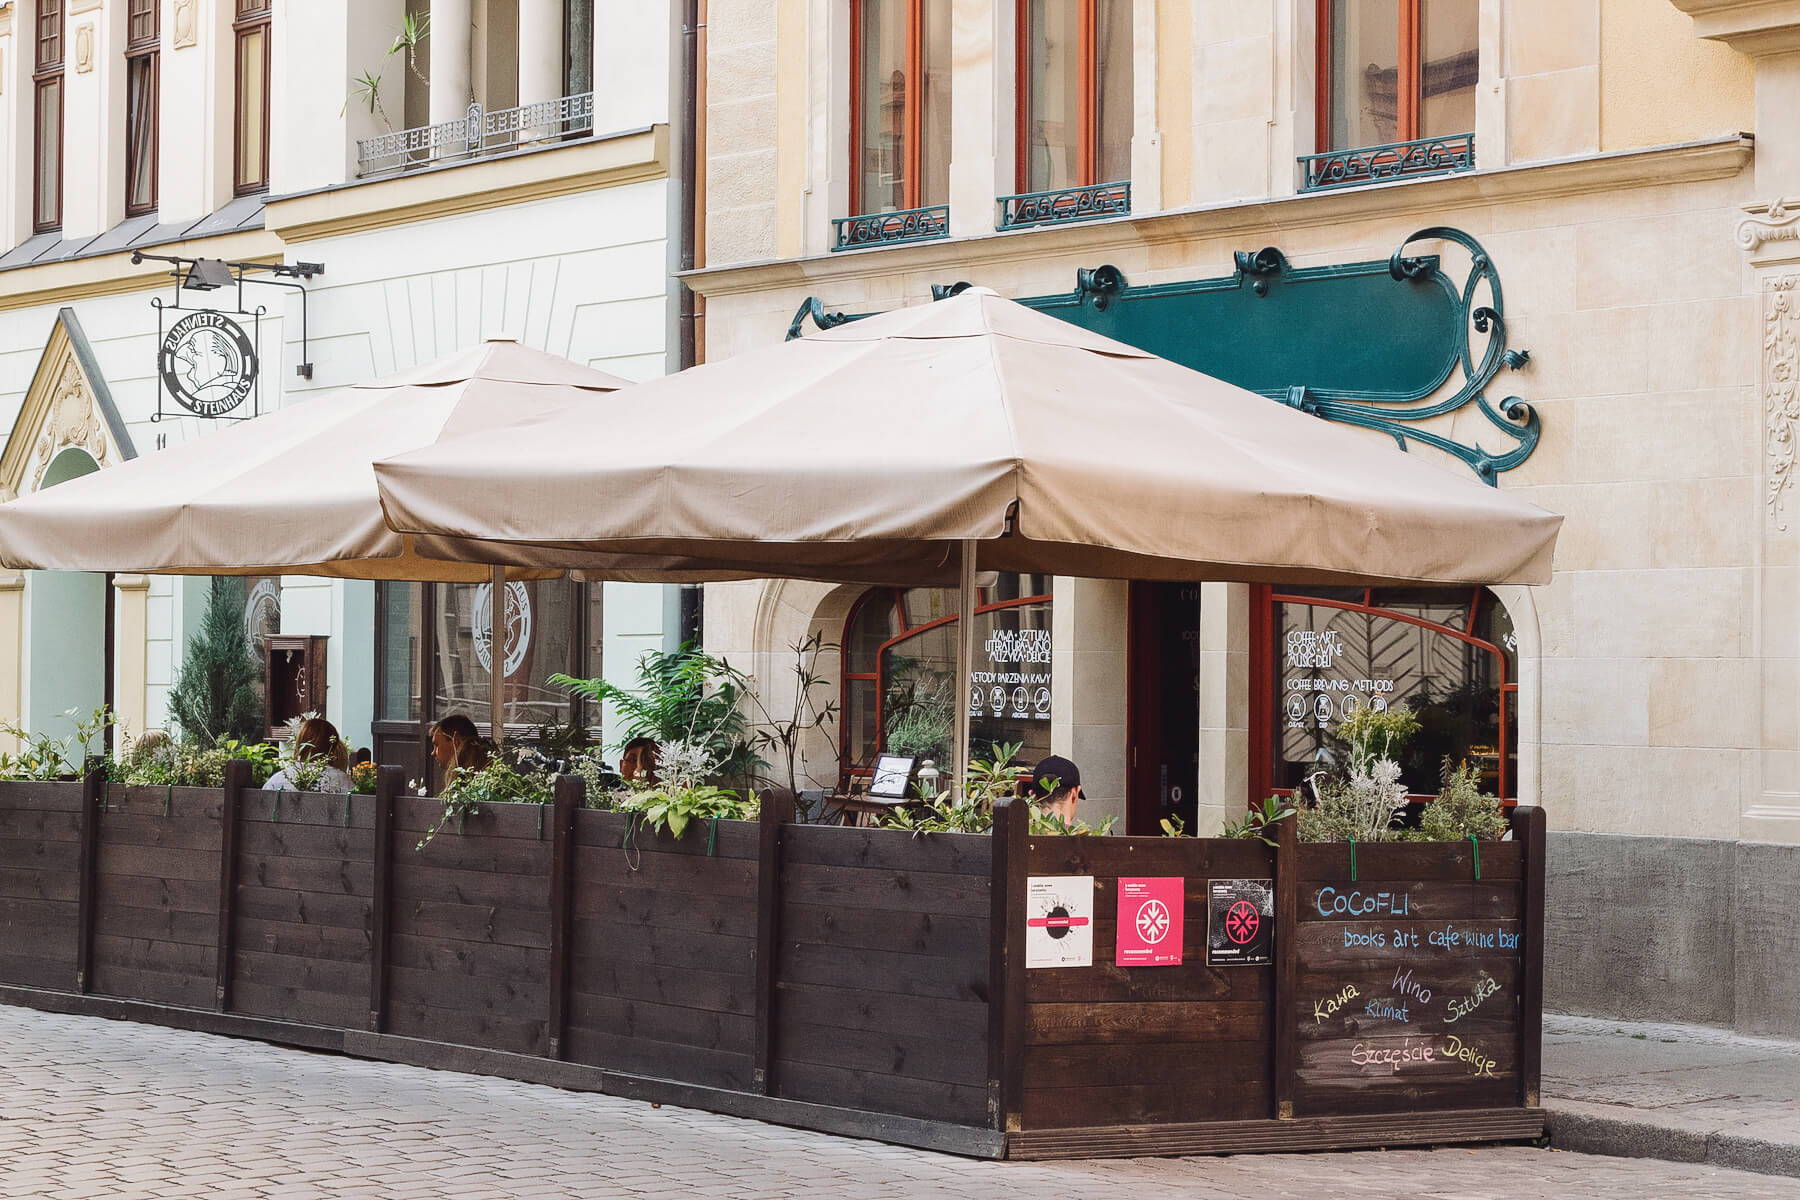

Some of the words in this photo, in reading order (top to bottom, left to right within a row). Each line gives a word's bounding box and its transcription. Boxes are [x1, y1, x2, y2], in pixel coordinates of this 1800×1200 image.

[194, 379, 250, 414] STEINHAUS
[992, 630, 1014, 641] KAWA
[1019, 630, 1050, 641] SZTUKA
[1287, 631, 1316, 644] COFFEE
[1319, 631, 1338, 643] ART
[1027, 640, 1051, 652] WINO
[1287, 643, 1316, 656] BOOKS
[1320, 643, 1343, 656] WINE
[989, 651, 1024, 663] MUZYKA
[1287, 655, 1314, 668] MUSIC
[1316, 655, 1332, 667] DELI
[1030, 673, 1051, 684] KAWY
[1287, 679, 1311, 690] COFFEE
[1313, 679, 1348, 691] BREWING
[1351, 679, 1393, 691] METHODS
[1344, 927, 1385, 948] books
[1393, 928, 1420, 948] art
[1428, 924, 1460, 950] cafe
[1465, 928, 1494, 949] wine
[1498, 927, 1520, 949] bar
[1392, 966, 1432, 1004] Wino
[1314, 984, 1360, 1024] Kawa
[1443, 977, 1502, 1023] Sztuka
[1364, 999, 1409, 1023] Klimat
[1351, 1038, 1436, 1070] Szczęście
